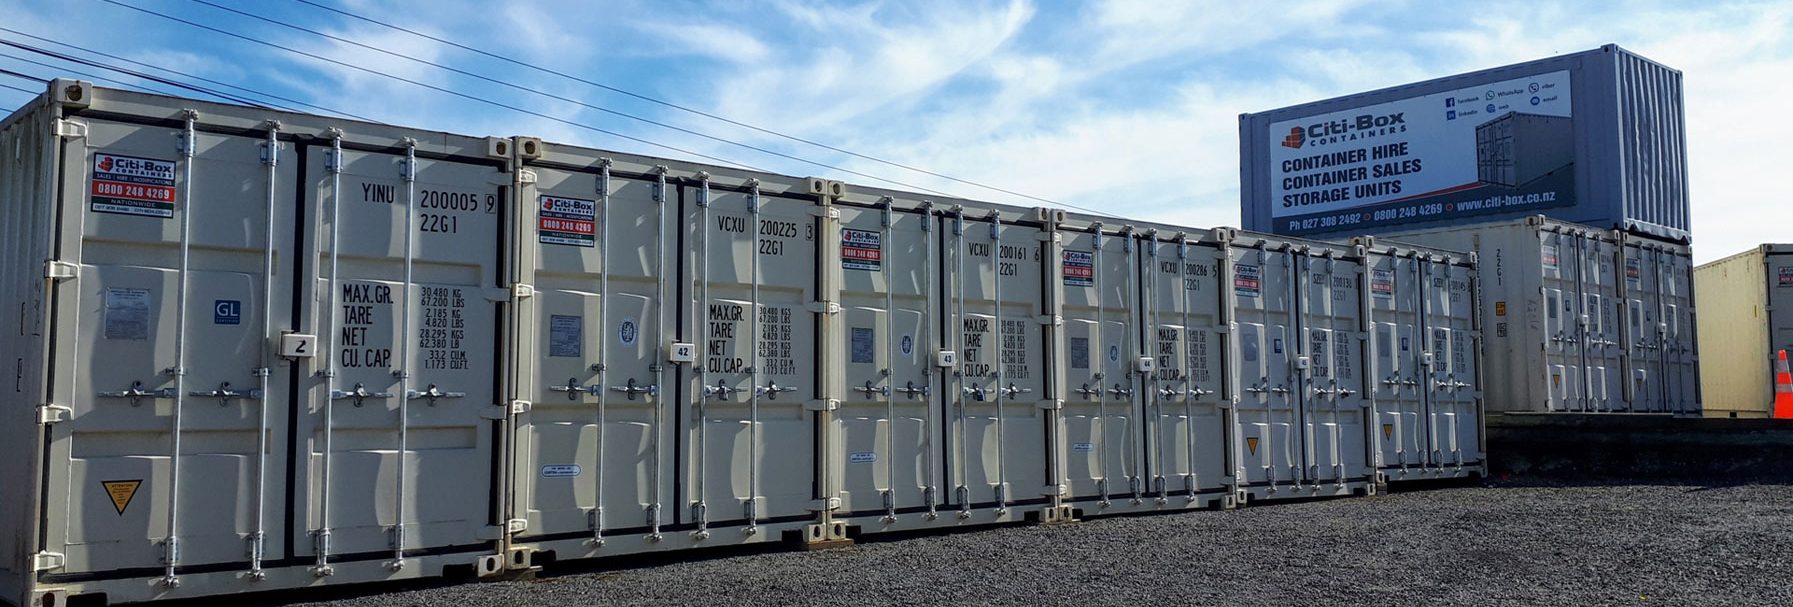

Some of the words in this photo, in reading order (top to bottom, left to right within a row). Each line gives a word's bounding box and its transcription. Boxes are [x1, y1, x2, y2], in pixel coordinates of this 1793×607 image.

[1458, 96, 1479, 104] facebook
[1498, 89, 1524, 98] WhatsApp
[1308, 112, 1405, 138] Citi-Box
[1310, 125, 1407, 147] CONTAINERS
[1282, 149, 1367, 173] CONTAINER
[1372, 142, 1409, 160] HIRE
[115, 158, 171, 173] Citi-Box
[116, 168, 172, 178] CONTAINERS
[1283, 167, 1368, 190] CONTAINER
[1373, 159, 1422, 178] SALES
[98, 183, 123, 195] 0800
[126, 186, 144, 197] 248
[146, 188, 170, 199] 4269
[362, 182, 394, 204] YINU
[420, 190, 478, 211] 200005
[486, 195, 495, 212] 9
[1283, 187, 1350, 208] STORAGE
[1355, 180, 1402, 199] UNITS
[111, 199, 157, 207] NATIONWIDE
[554, 199, 592, 210] Citi-Box
[1289, 220, 1300, 231] Ph
[1302, 218, 1318, 229] 027
[1320, 216, 1336, 227] 308
[1339, 213, 1361, 225] 2492
[1374, 208, 1397, 221] 0800
[1399, 206, 1416, 218] 248
[1419, 203, 1443, 216] 4269
[1457, 191, 1556, 211] www.citi-box.co.nz
[420, 214, 457, 233] 22G1
[718, 216, 745, 233] VCXU
[760, 220, 797, 238] 200225
[807, 225, 813, 240] 3
[760, 239, 783, 256] 22G1
[969, 243, 989, 257] VCXU
[1000, 245, 1027, 260] 200161
[1000, 262, 1017, 276] 22G1
[421, 287, 448, 297] 30.480
[216, 302, 239, 316] GL
[421, 297, 448, 307] 67.200
[452, 298, 465, 308] LBS
[343, 305, 373, 325] TARE
[426, 308, 447, 318] 2.185
[425, 319, 447, 328] 4.820
[452, 319, 464, 328] LBS
[709, 322, 732, 338] TARE
[341, 327, 367, 346] NET
[420, 329, 447, 339] 28.295
[451, 330, 464, 340] KGS
[964, 334, 982, 347] TARE
[294, 340, 306, 353] 2
[420, 339, 446, 348] 62.380
[709, 340, 726, 356] NET
[341, 349, 361, 368] CU.
[365, 349, 392, 368] CAP.
[678, 348, 688, 356] 42
[944, 355, 952, 363] 43
[964, 349, 976, 362] NET
